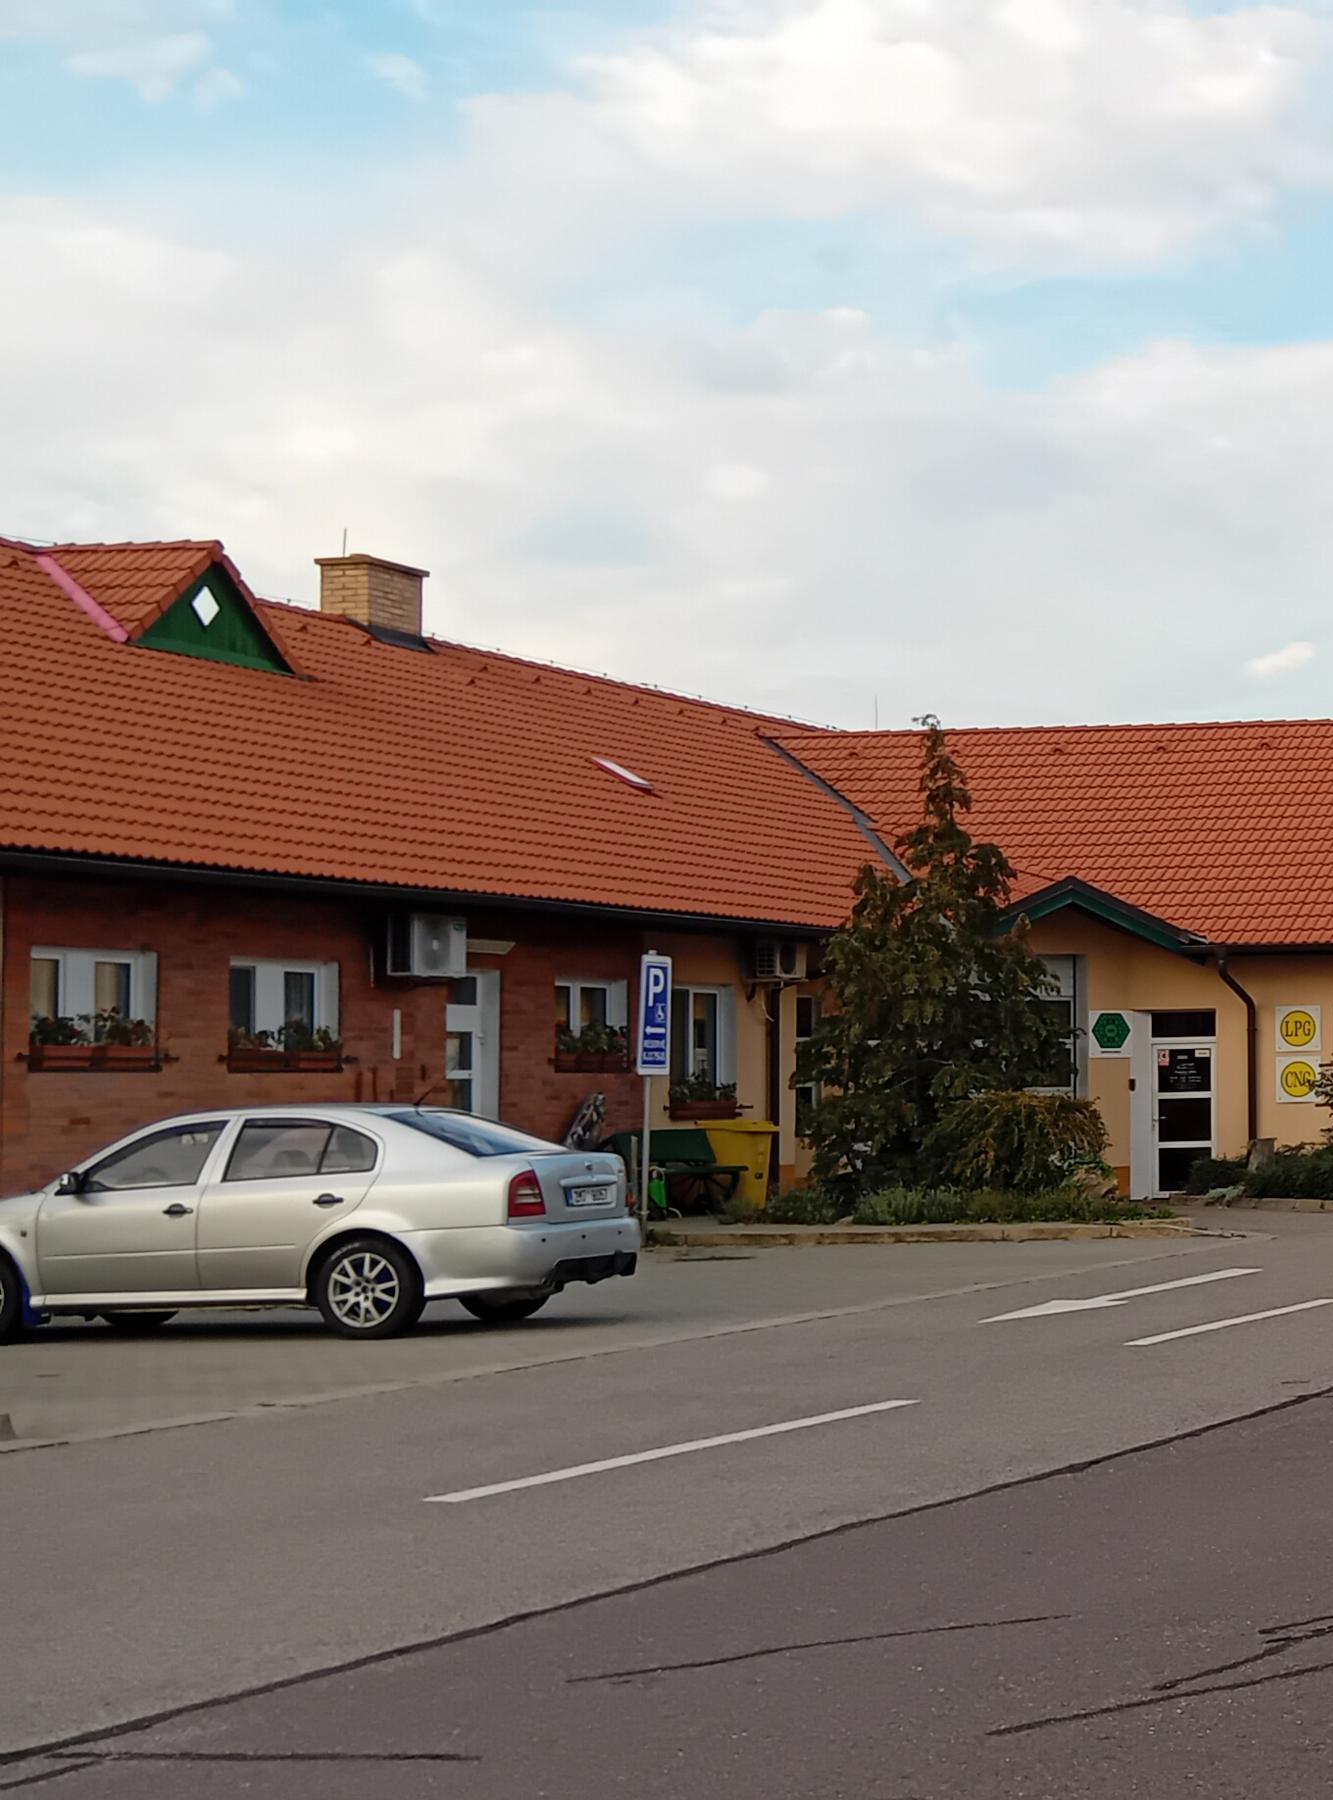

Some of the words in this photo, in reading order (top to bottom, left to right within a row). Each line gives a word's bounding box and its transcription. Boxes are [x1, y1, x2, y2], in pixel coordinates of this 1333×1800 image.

[648, 967, 665, 1007] P
[1284, 1020, 1311, 1037] LPG
[1285, 1071, 1311, 1088] CNG
